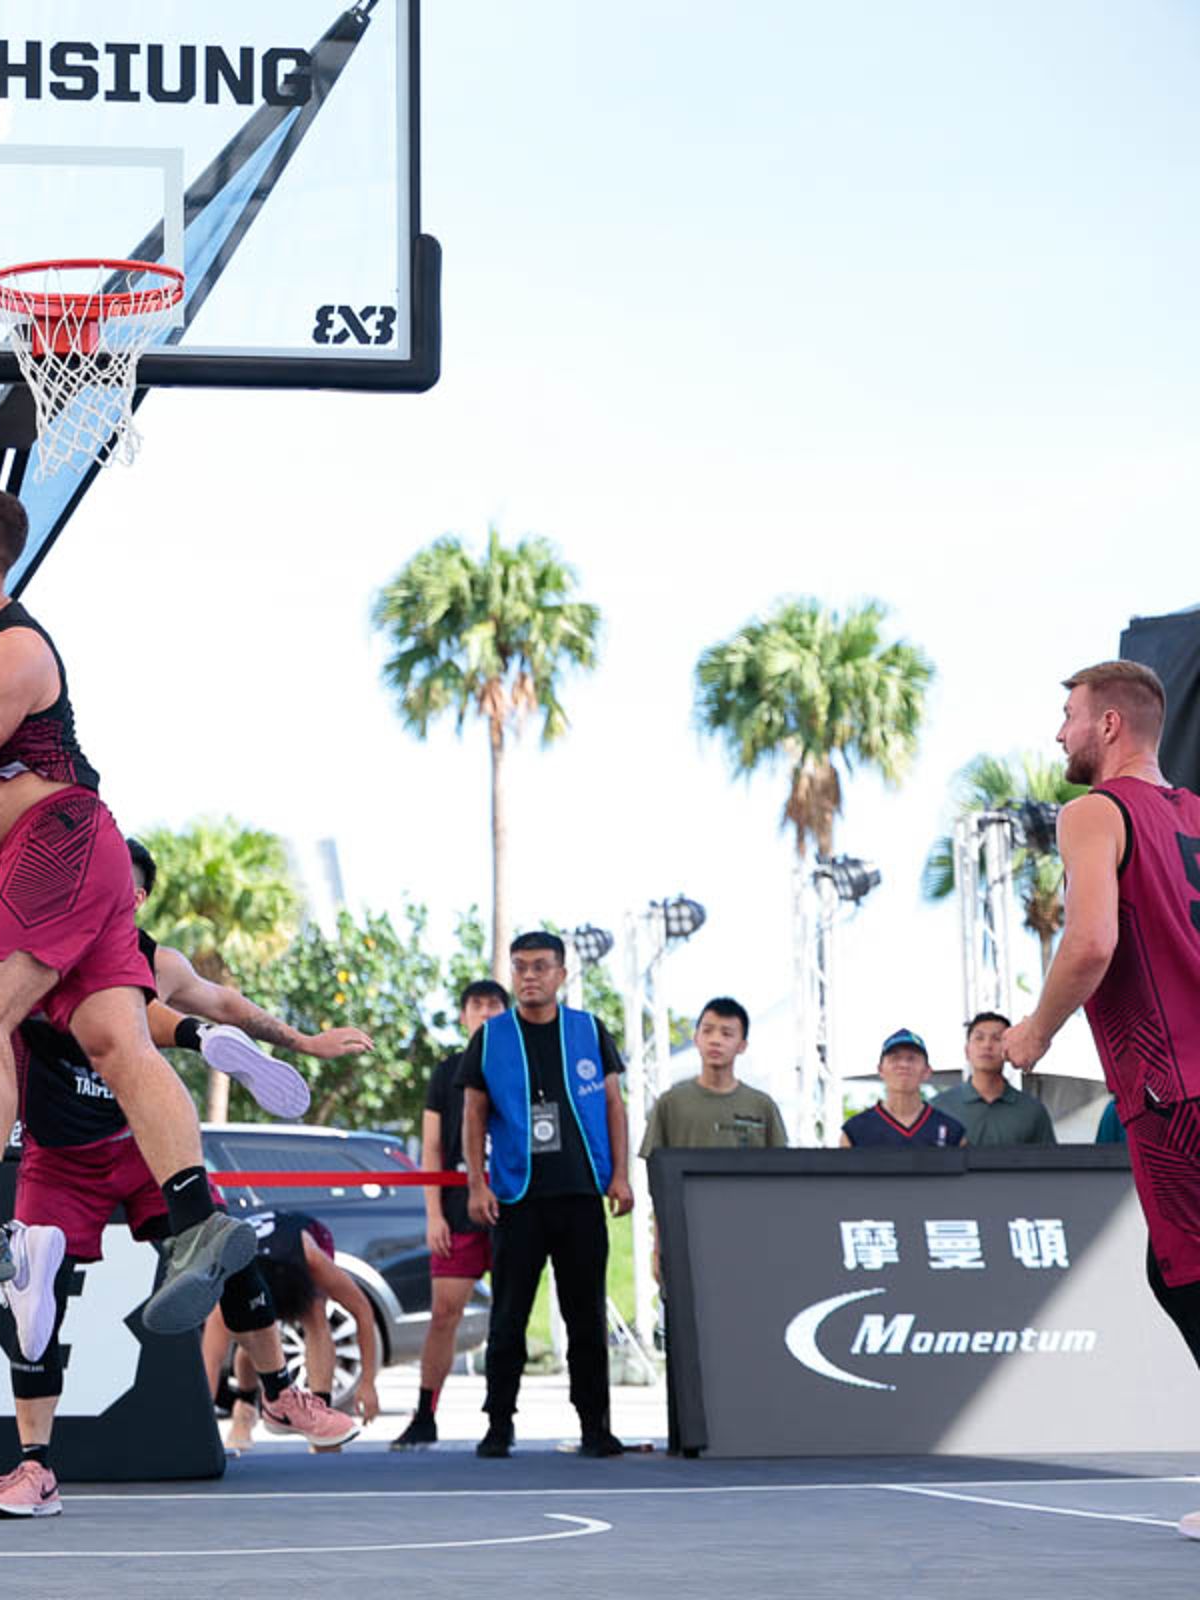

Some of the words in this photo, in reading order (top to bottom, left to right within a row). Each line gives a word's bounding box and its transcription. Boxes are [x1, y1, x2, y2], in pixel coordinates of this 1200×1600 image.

[840, 1218, 1070, 1270] 摩曼頓
[850, 1313, 1098, 1355] Momentum
